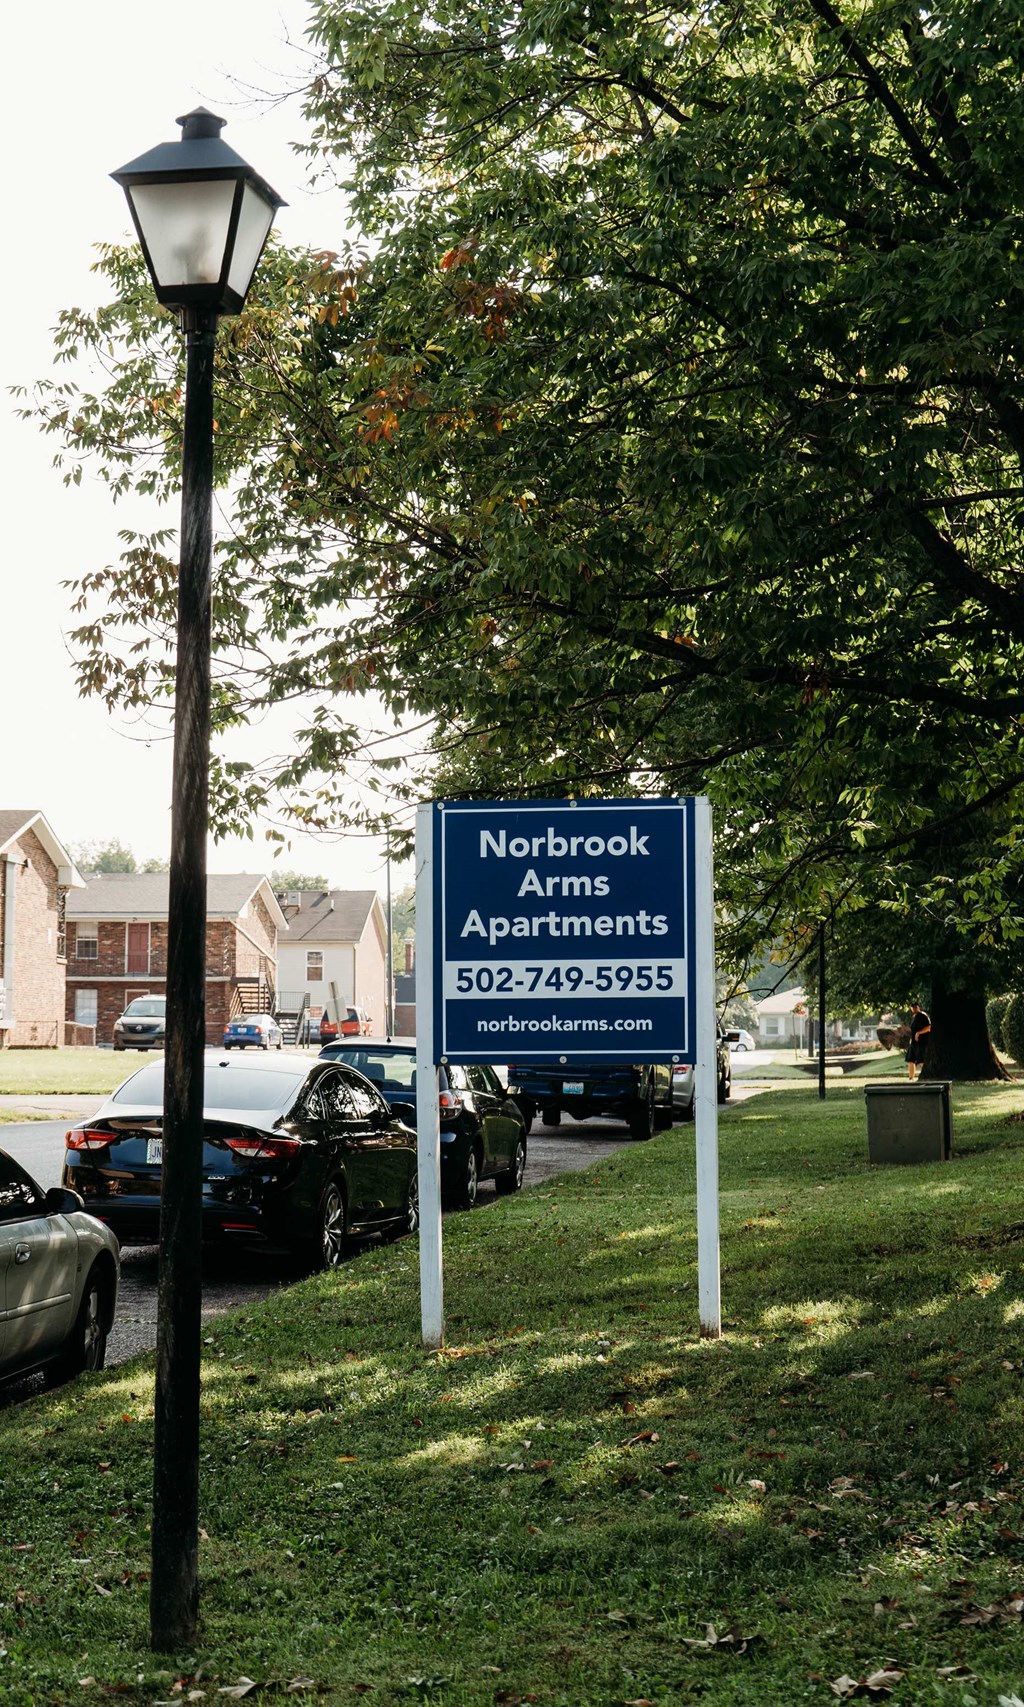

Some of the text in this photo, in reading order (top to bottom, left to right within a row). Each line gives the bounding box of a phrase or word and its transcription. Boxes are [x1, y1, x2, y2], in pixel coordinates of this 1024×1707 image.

[480, 826, 650, 858] Norbrook
[517, 869, 610, 897] Arms
[460, 909, 669, 946] Apartments
[456, 965, 674, 993] 502-749-5955
[477, 1015, 653, 1032] norbrookarms.com
